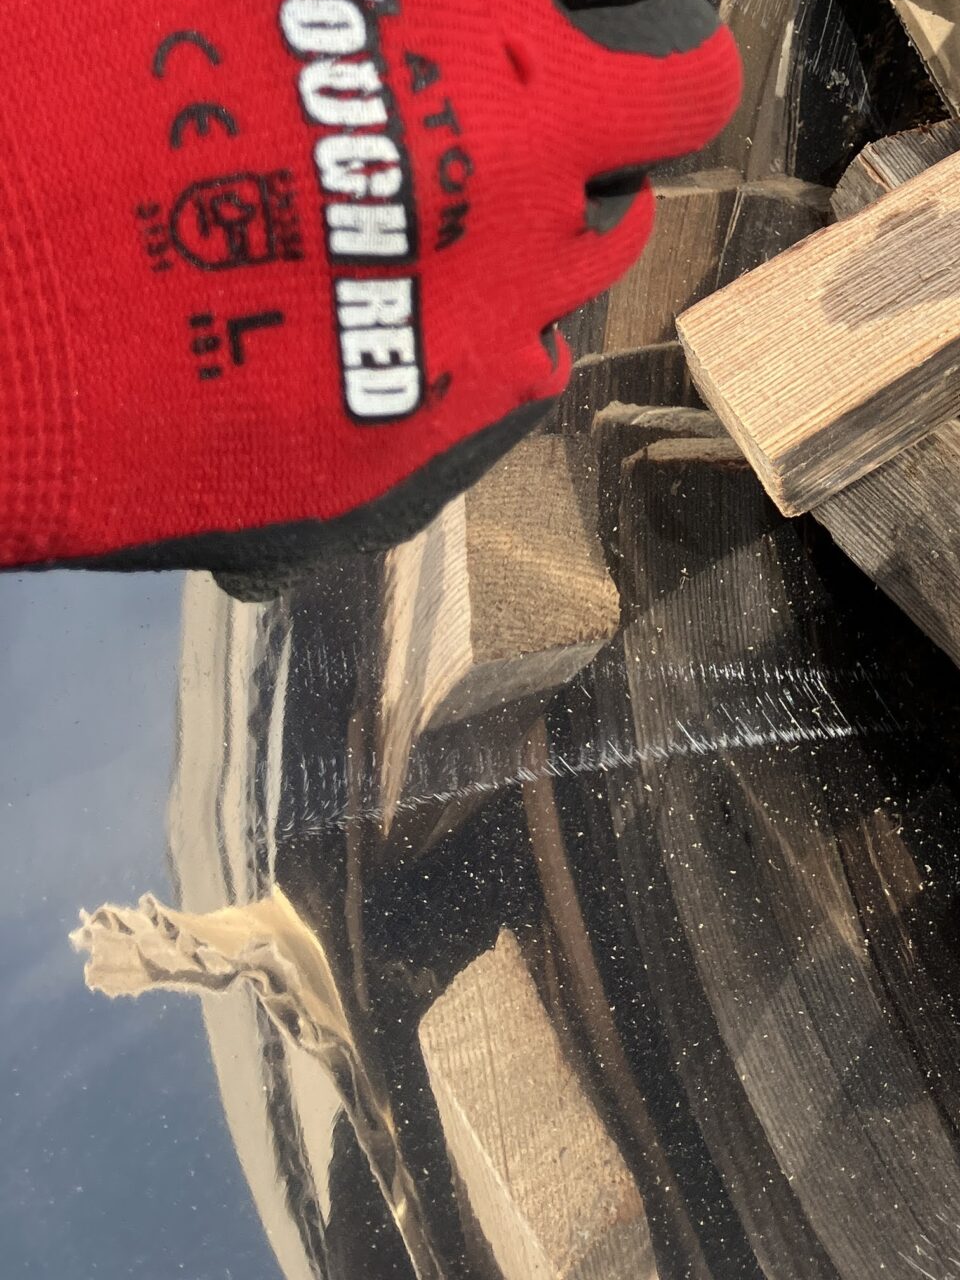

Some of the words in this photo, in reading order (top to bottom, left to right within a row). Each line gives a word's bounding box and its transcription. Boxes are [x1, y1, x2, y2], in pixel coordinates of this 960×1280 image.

[404, 50, 474, 252] ATOM
[227, 310, 285, 366] L
[334, 274, 427, 426] RED
